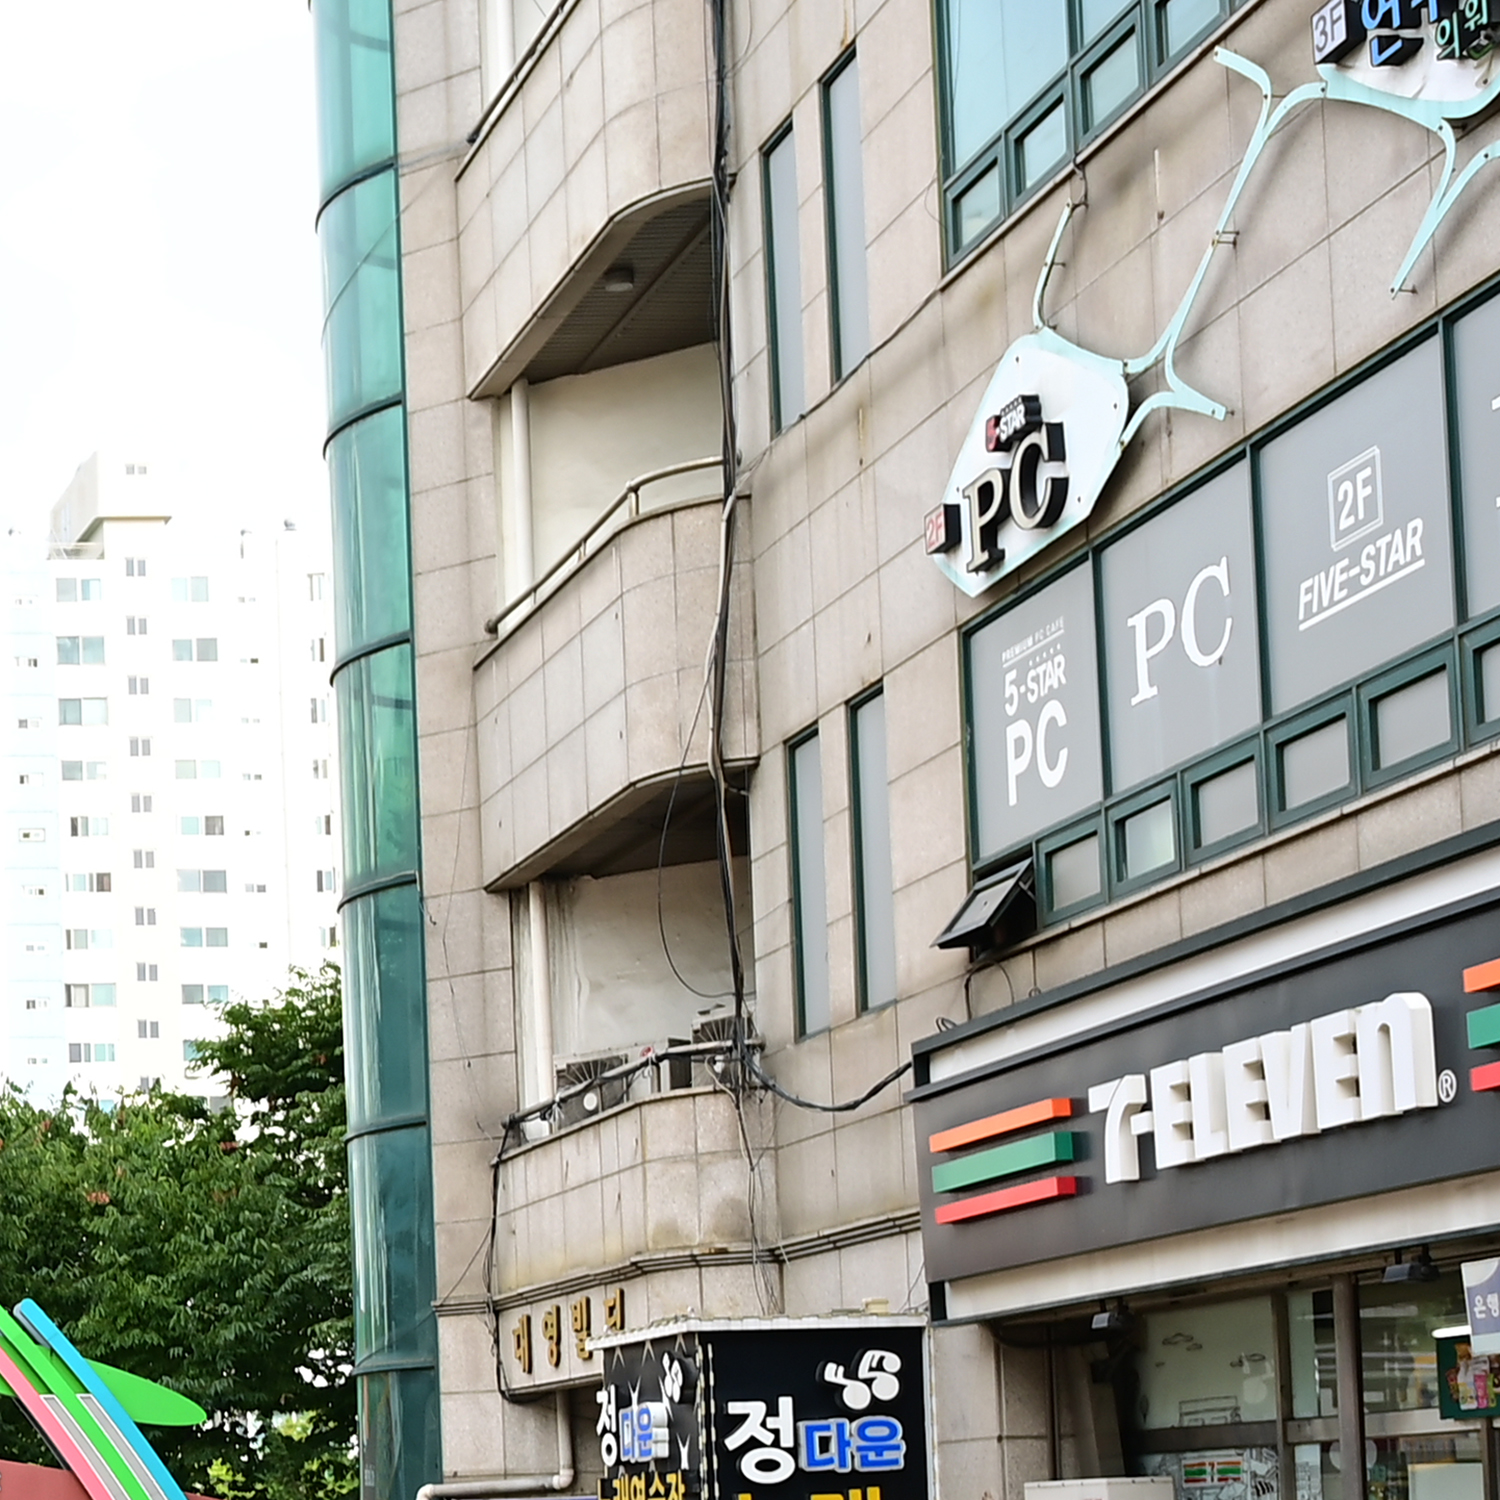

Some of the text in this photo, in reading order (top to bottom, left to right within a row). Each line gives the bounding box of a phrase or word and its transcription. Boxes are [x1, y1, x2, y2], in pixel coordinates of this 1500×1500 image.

[1315, 3, 1342, 52] 3F
[927, 511, 943, 548] 2F
[962, 422, 1052, 572] PC
[1337, 466, 1372, 531] 2F
[1299, 517, 1424, 621] FIVE-STAR
[1002, 615, 1065, 663] PREMIUM PC CAFE
[1127, 556, 1232, 706] PC
[1005, 654, 1066, 716] 5-STAR
[1006, 700, 1068, 806] PC
[596, 1385, 653, 1467] 정다운
[725, 1397, 905, 1484] 정다운
